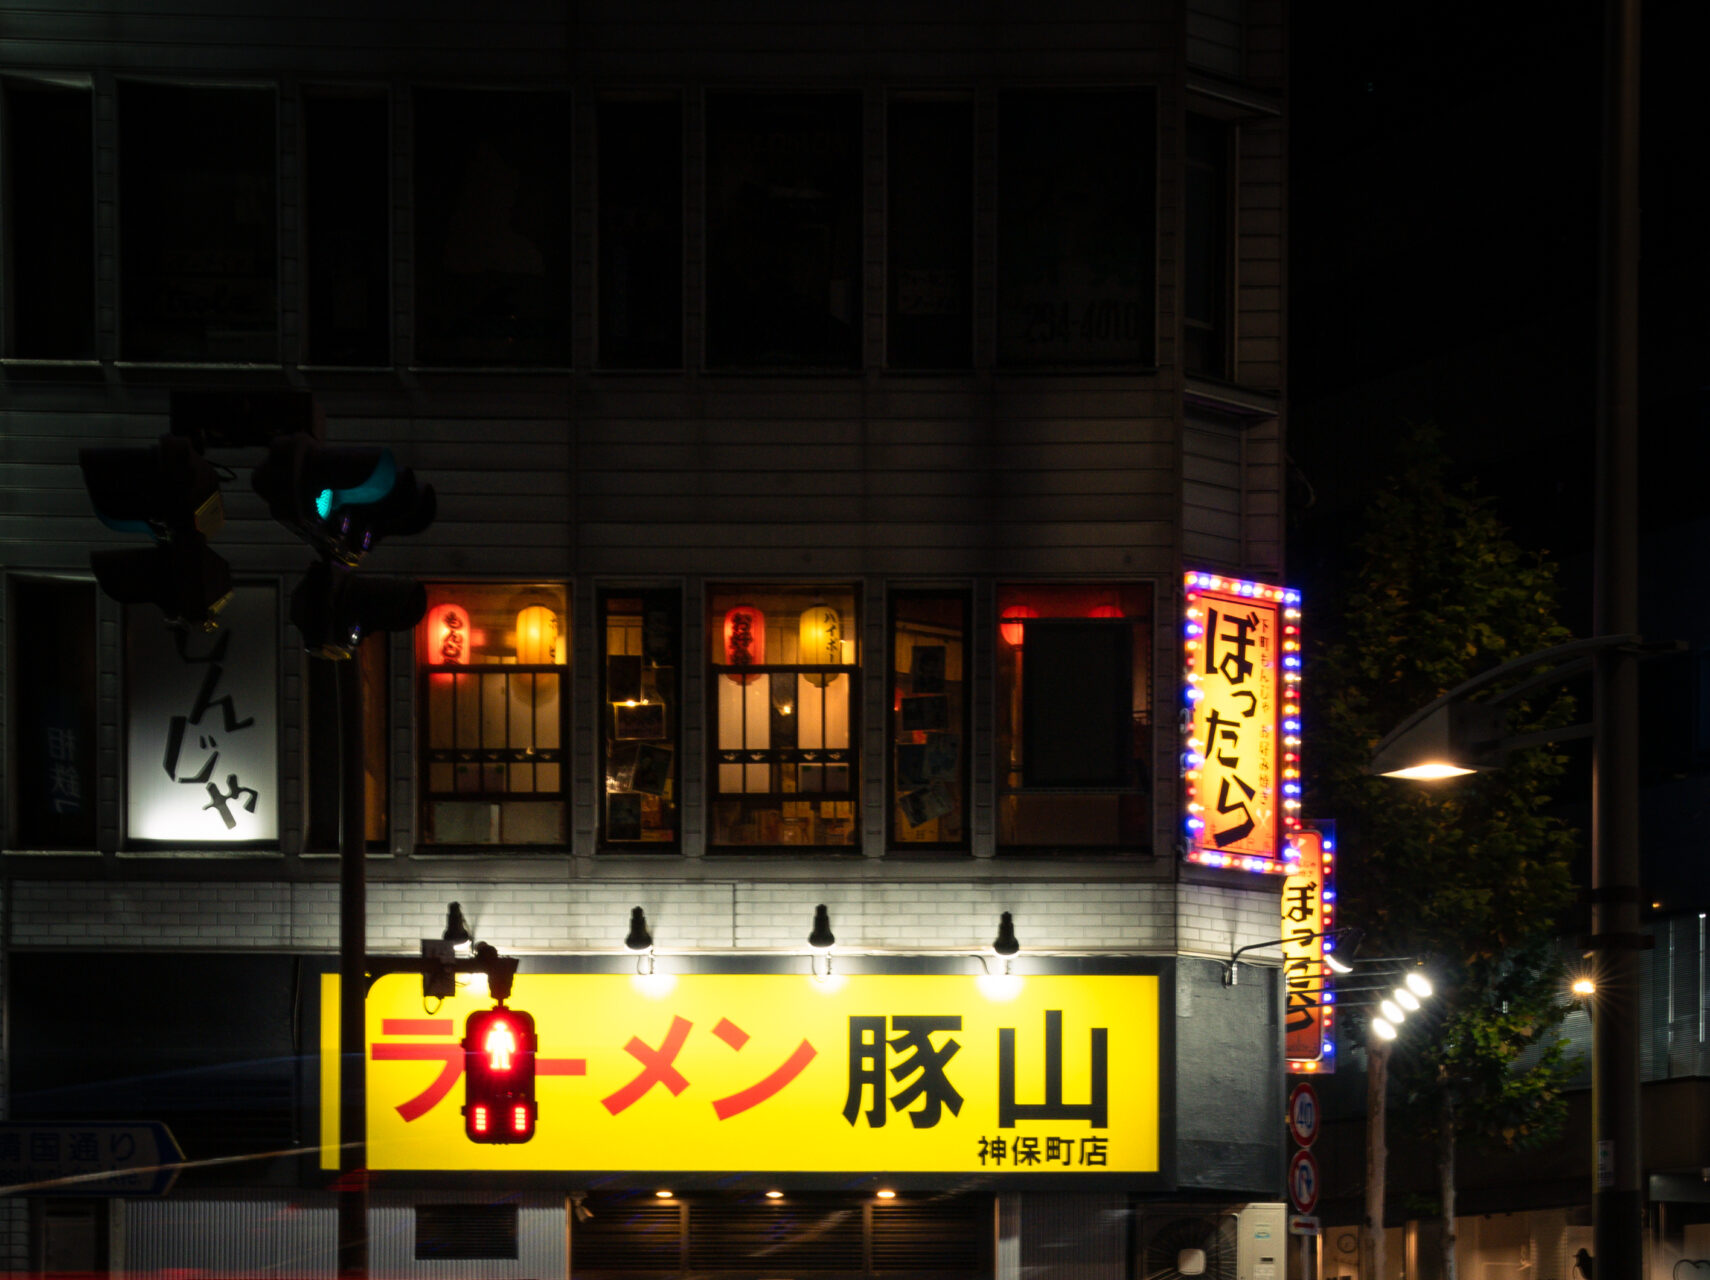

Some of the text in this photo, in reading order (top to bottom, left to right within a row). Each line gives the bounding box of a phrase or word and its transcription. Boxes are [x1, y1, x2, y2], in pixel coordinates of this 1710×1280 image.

[1204, 606, 1259, 848] ぼったら
[1296, 1100, 1313, 1129] 40
[977, 1134, 1109, 1167] 神保町店
